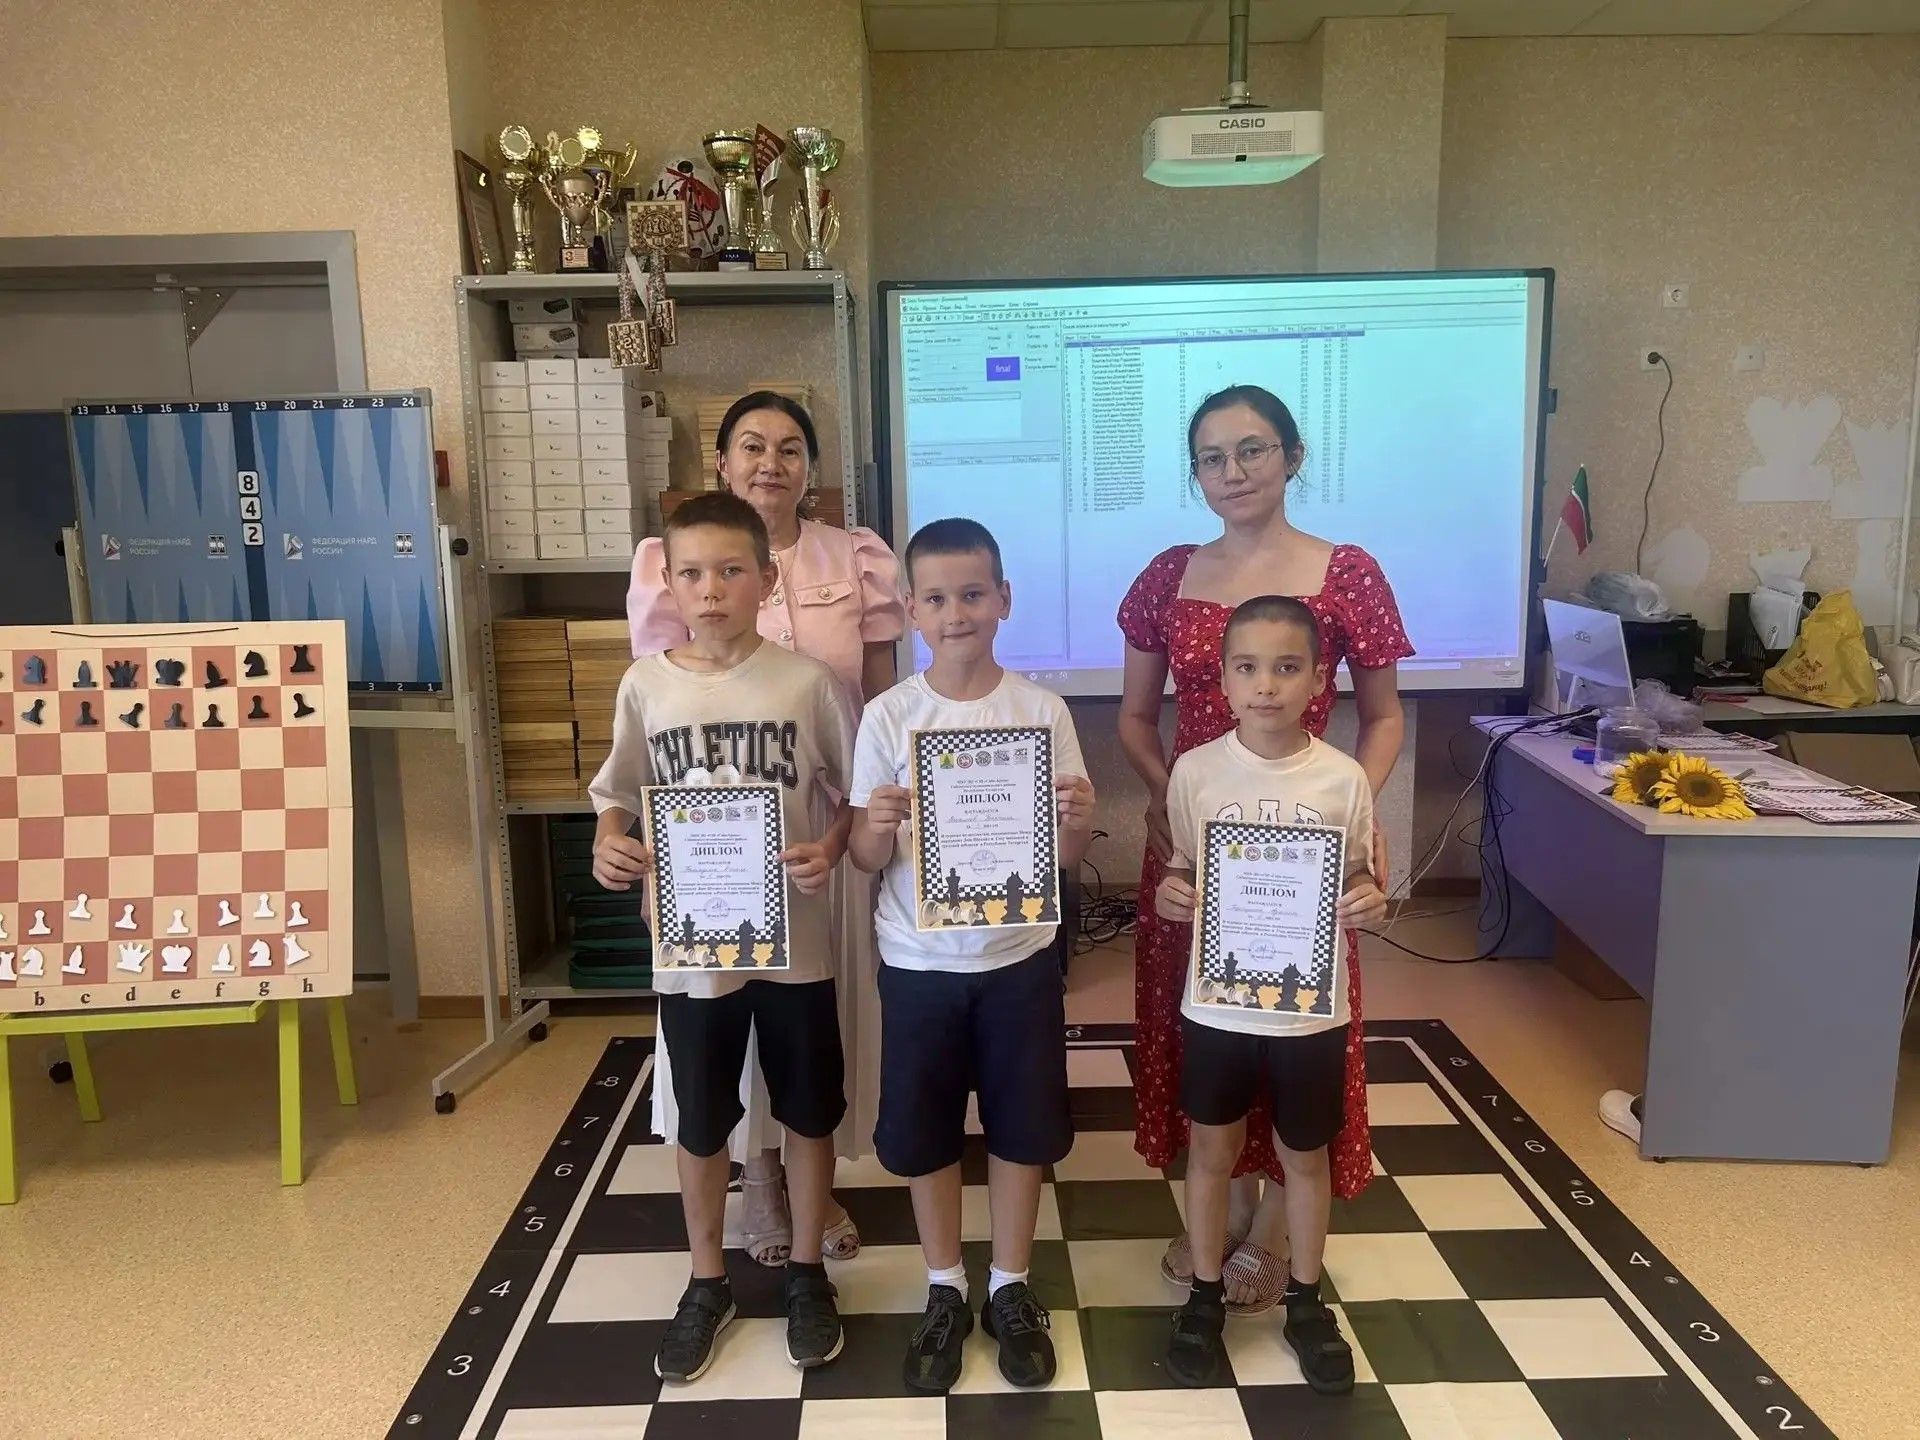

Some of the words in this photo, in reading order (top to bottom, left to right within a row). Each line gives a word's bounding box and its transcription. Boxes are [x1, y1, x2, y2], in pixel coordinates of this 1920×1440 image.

[1219, 118, 1265, 129] CASIO
[77, 406, 89, 415] 13
[105, 405, 117, 415] 14
[132, 404, 143, 414] 15
[160, 404, 172, 413] 16
[188, 403, 200, 412] 17
[217, 402, 229, 412] 18
[255, 401, 267, 411] 19
[284, 400, 297, 410] 20
[312, 400, 325, 409] 21
[342, 399, 355, 408] 22
[372, 398, 385, 407] 23
[402, 397, 415, 407] 24
[243, 475, 254, 491] 8
[246, 501, 256, 516] 4
[248, 527, 259, 542] 2
[312, 537, 355, 545] ФЕДЕРАЦИЯ
[357, 537, 377, 545] НАРД
[368, 682, 375, 691] 3
[397, 682, 404, 691] 2
[427, 682, 434, 692] 1
[648, 720, 799, 791] THLETICS
[955, 793, 1011, 805] ДИПЛОМ
[690, 847, 743, 857] ДИПЛОМ
[1240, 886, 1297, 899] ДИПЛОМ
[34, 991, 45, 1006] b
[81, 992, 90, 1004] c
[125, 986, 136, 1001] d
[171, 988, 181, 999] e
[215, 982, 224, 997] f
[259, 981, 270, 996] g
[302, 978, 313, 993] h
[1448, 1056, 1469, 1067] 8
[603, 1076, 620, 1087] 8
[1481, 1095, 1498, 1107] 7
[581, 1117, 599, 1128] 7
[1524, 1139, 1546, 1154] 6
[554, 1163, 574, 1177] 6
[1570, 1190, 1595, 1207] 5
[524, 1216, 547, 1232] 5
[1629, 1252, 1652, 1268] 4
[488, 1280, 512, 1297] 4
[1689, 1322, 1720, 1343] 3
[446, 1355, 474, 1376] 3
[1766, 1405, 1804, 1431] 2
